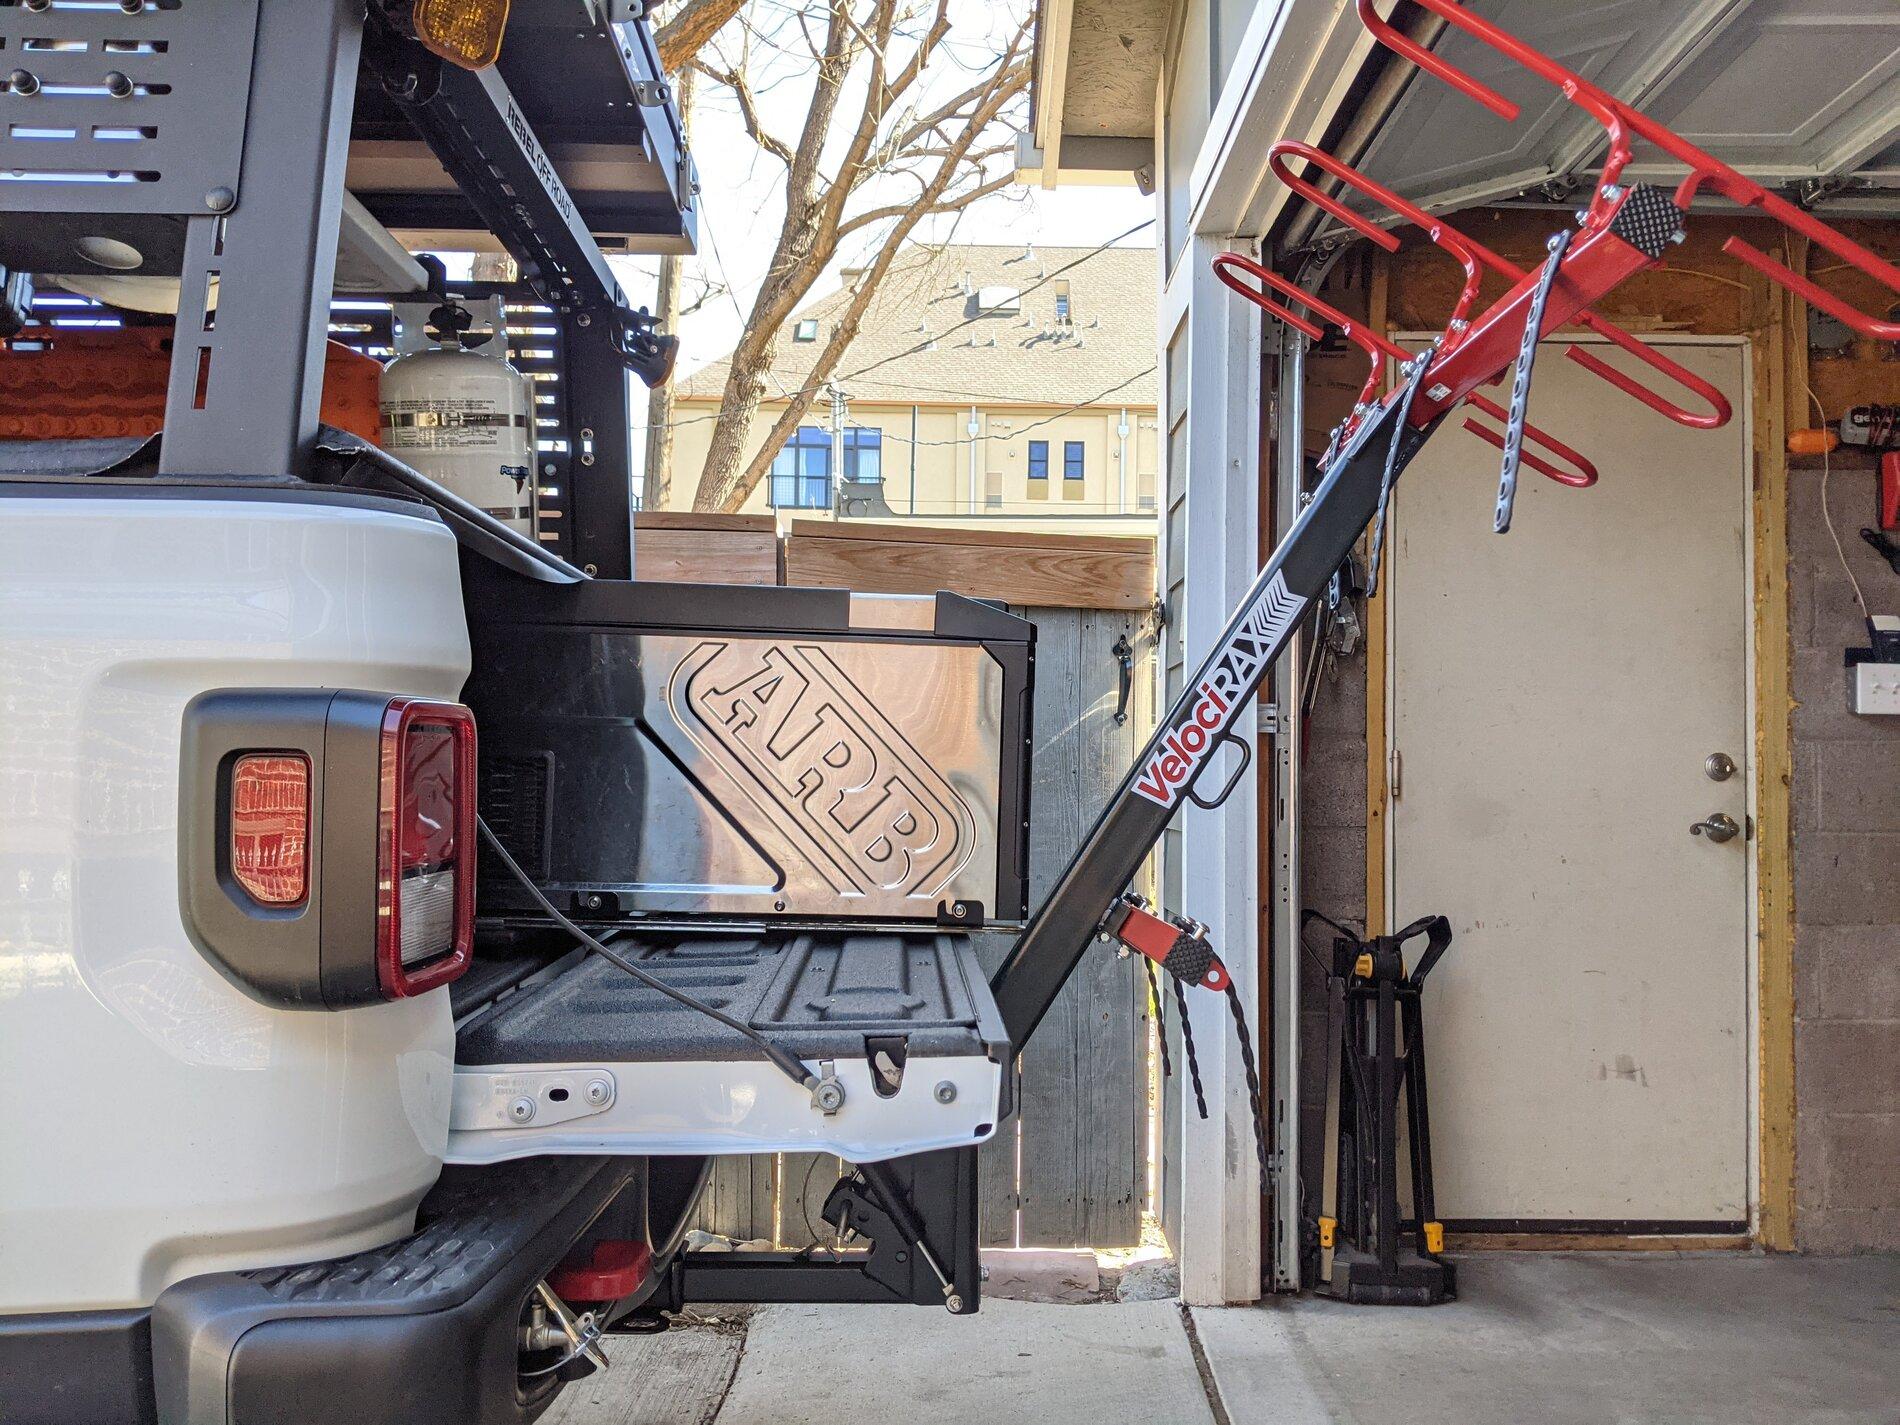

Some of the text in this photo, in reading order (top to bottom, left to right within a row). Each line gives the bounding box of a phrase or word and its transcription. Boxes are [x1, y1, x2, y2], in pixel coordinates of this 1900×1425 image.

[507, 102, 572, 219] REBEL OFF ROAD
[700, 646, 939, 889] ARB
[1137, 621, 1271, 803] VelociRAX
